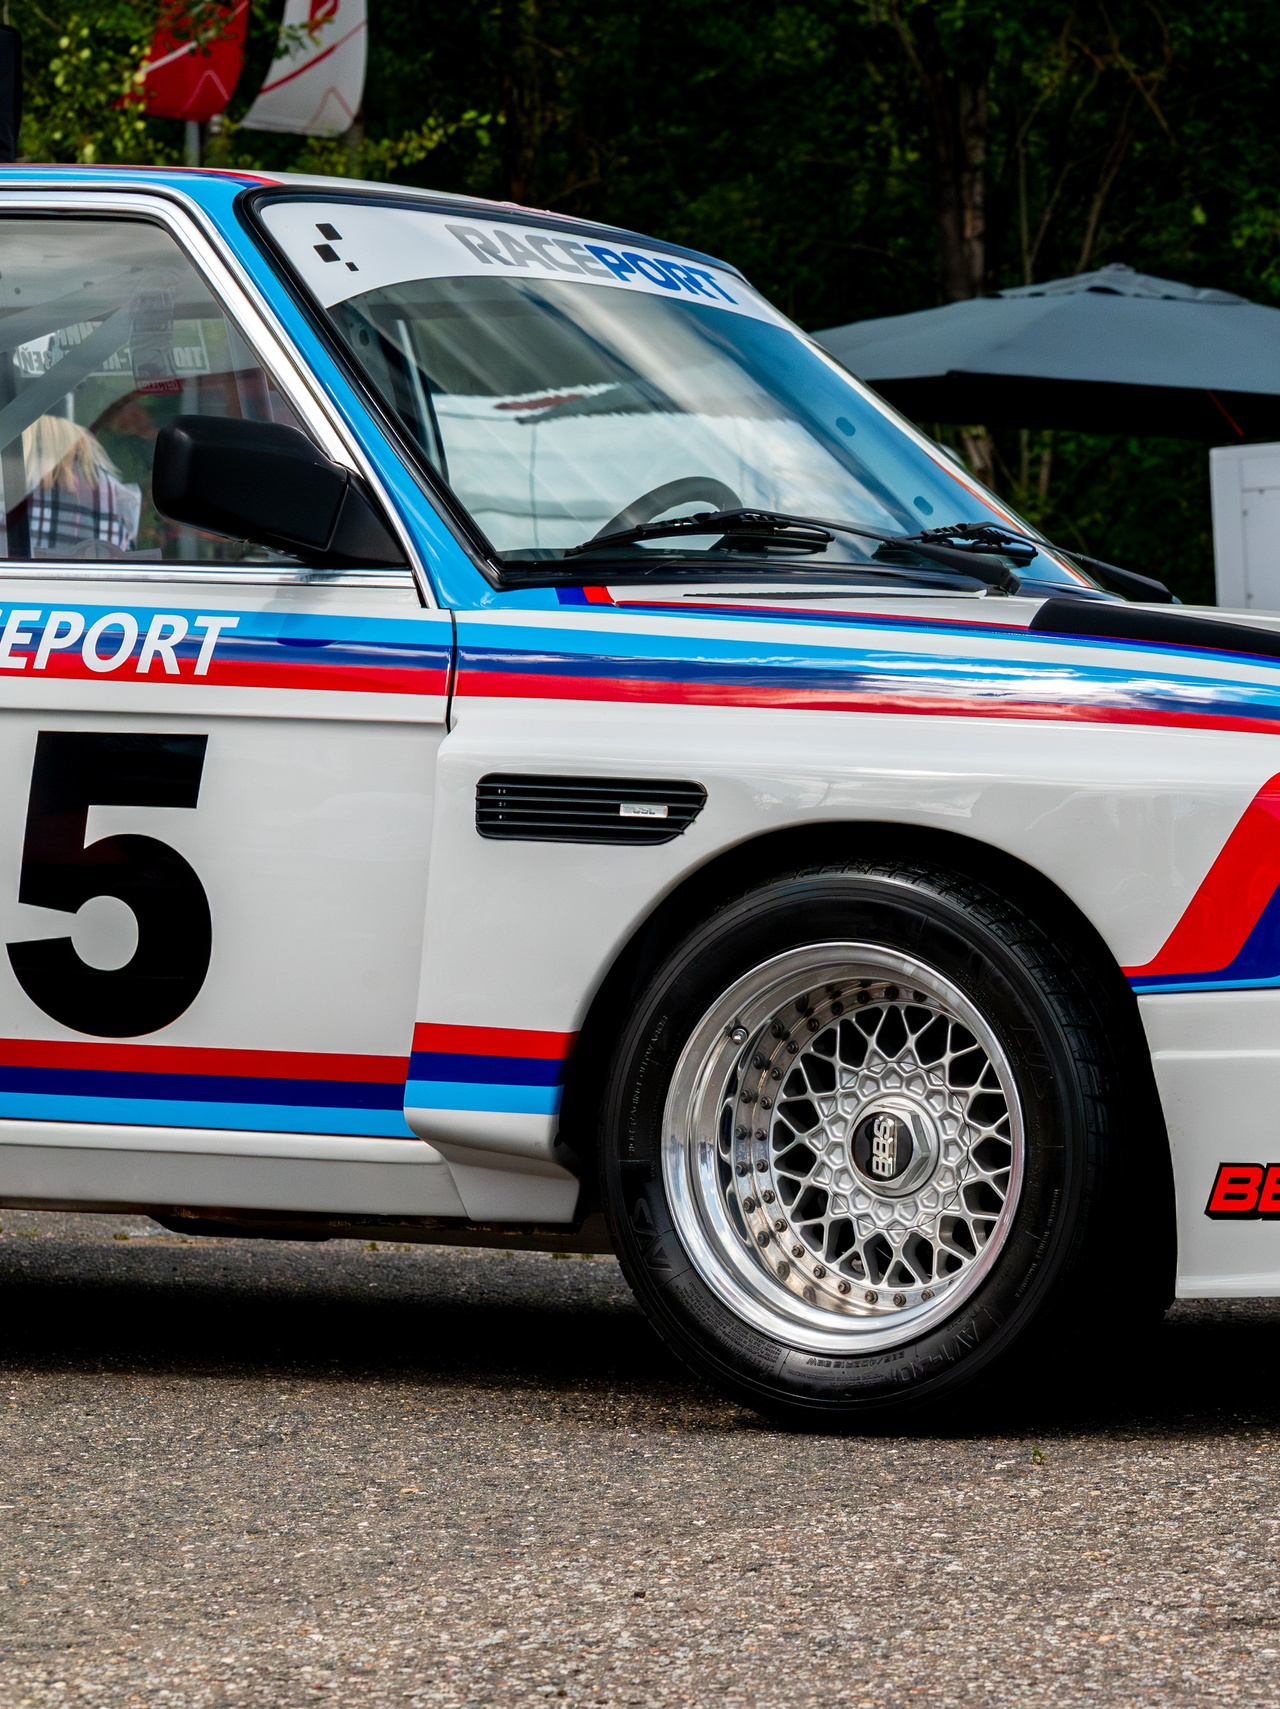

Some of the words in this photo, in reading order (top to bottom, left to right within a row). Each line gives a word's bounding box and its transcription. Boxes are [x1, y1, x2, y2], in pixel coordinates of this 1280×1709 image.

[444, 224, 739, 305] RACEPORT
[0, 609, 240, 676] EPORT
[6, 730, 212, 1039] 5
[872, 1116, 895, 1177] BBS
